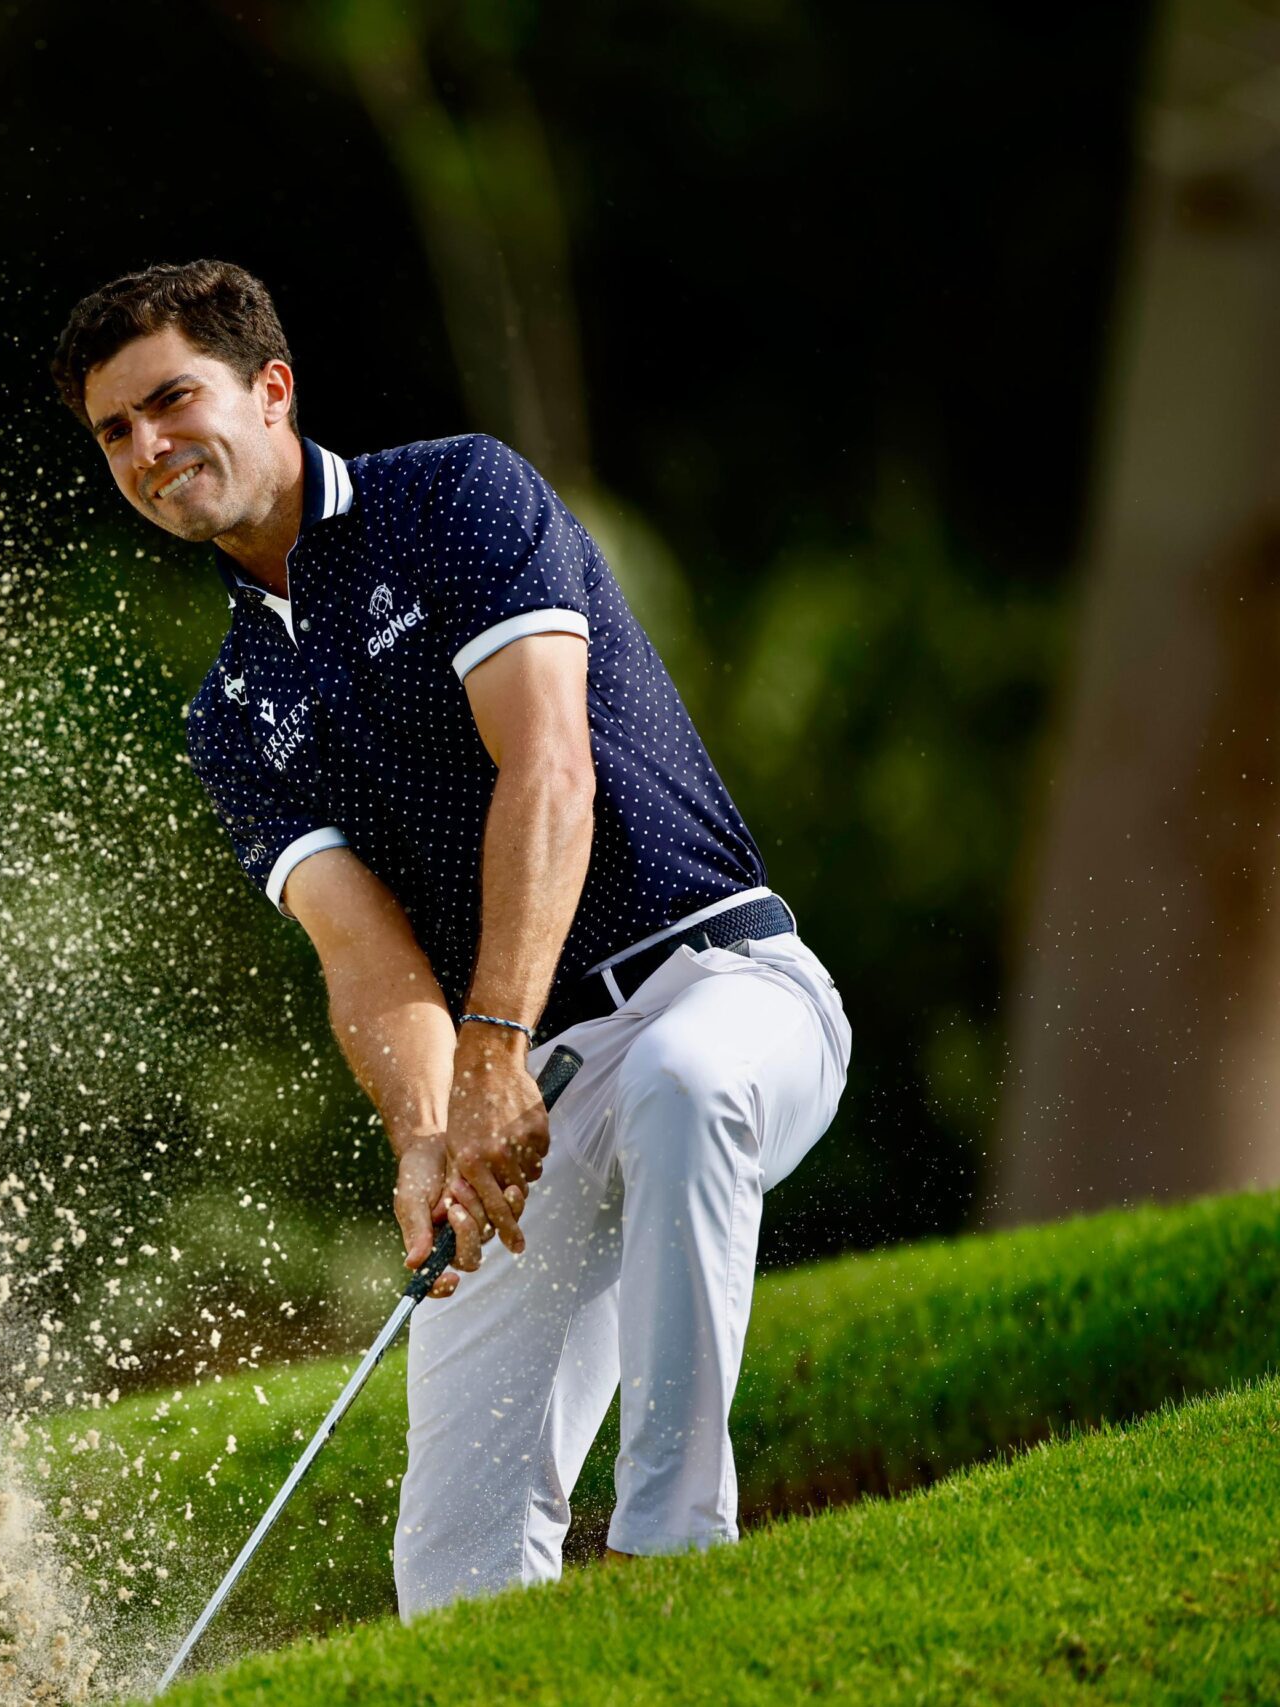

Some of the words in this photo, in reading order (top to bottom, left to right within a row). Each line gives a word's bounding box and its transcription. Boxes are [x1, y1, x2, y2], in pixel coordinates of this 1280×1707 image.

[367, 602, 425, 656] GigNet
[273, 727, 305, 771] BANK
[240, 839, 266, 869] SON
